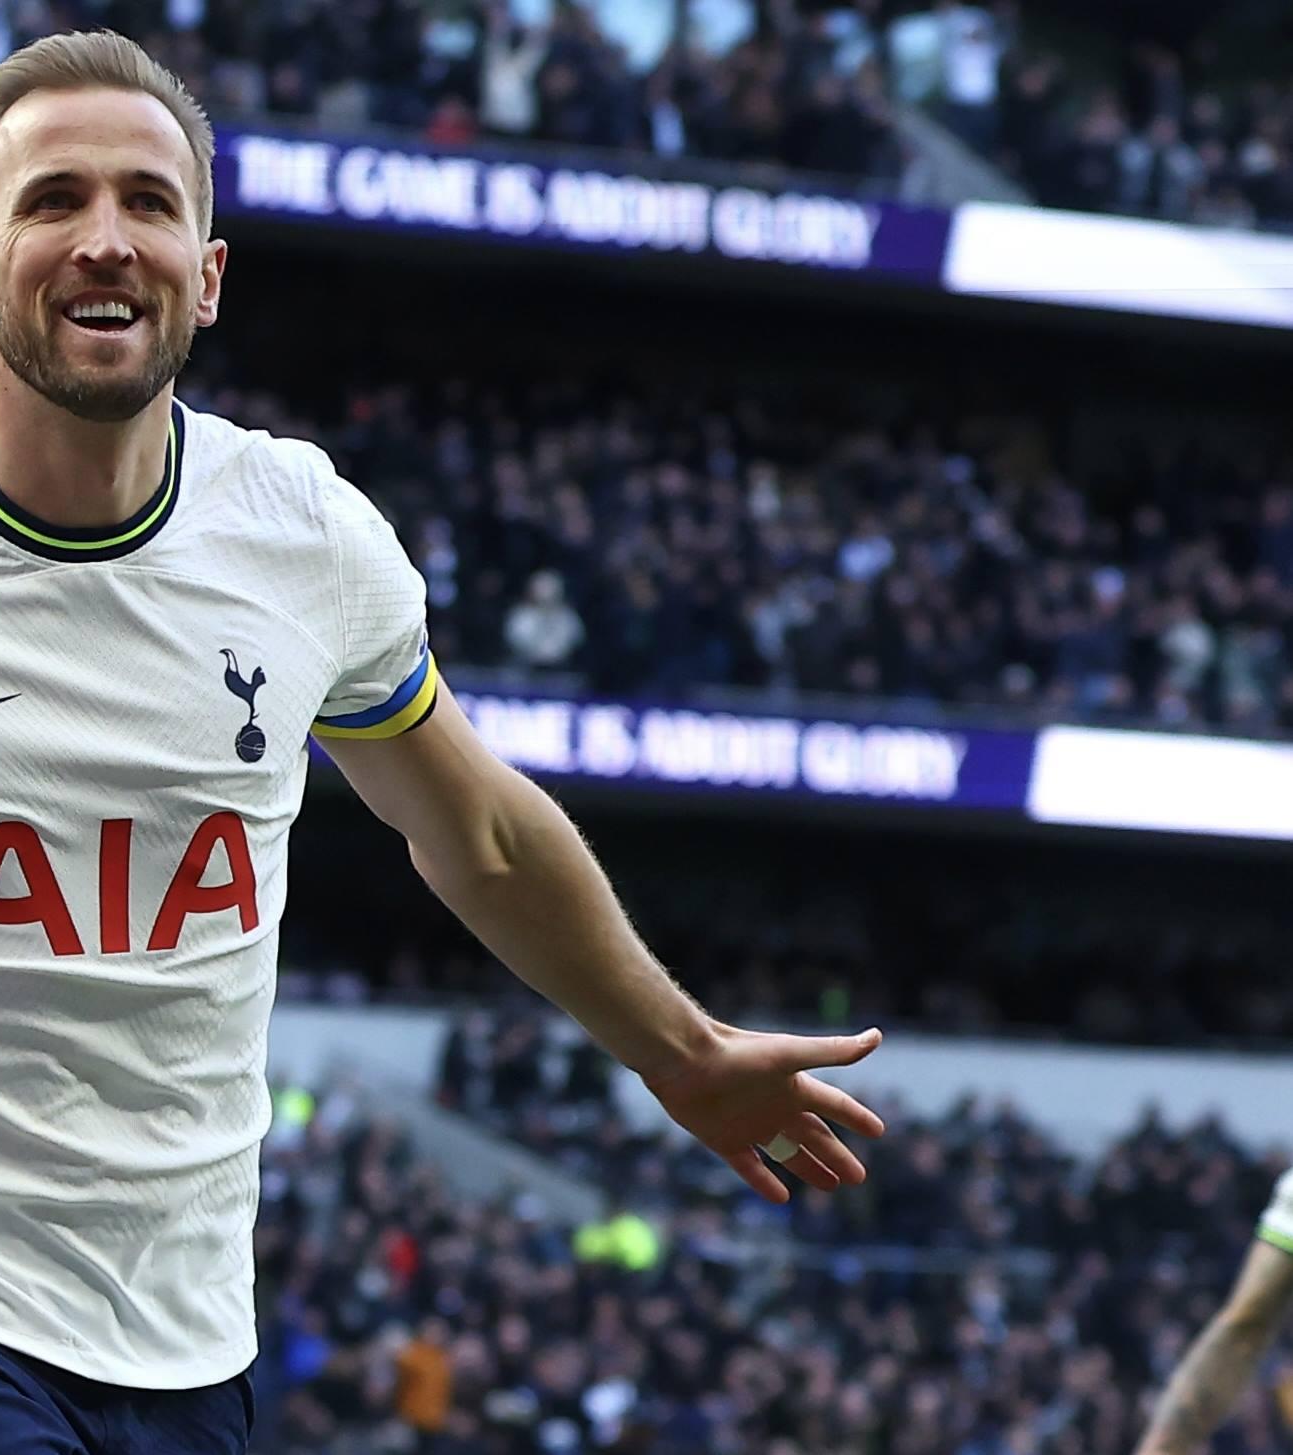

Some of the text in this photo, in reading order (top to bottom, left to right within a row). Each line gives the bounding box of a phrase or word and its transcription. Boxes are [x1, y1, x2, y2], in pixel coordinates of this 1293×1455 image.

[236, 136, 877, 267] THE GAME IS ABOUT GLORY
[456, 693, 964, 800] AME IS ABOUT GLORY
